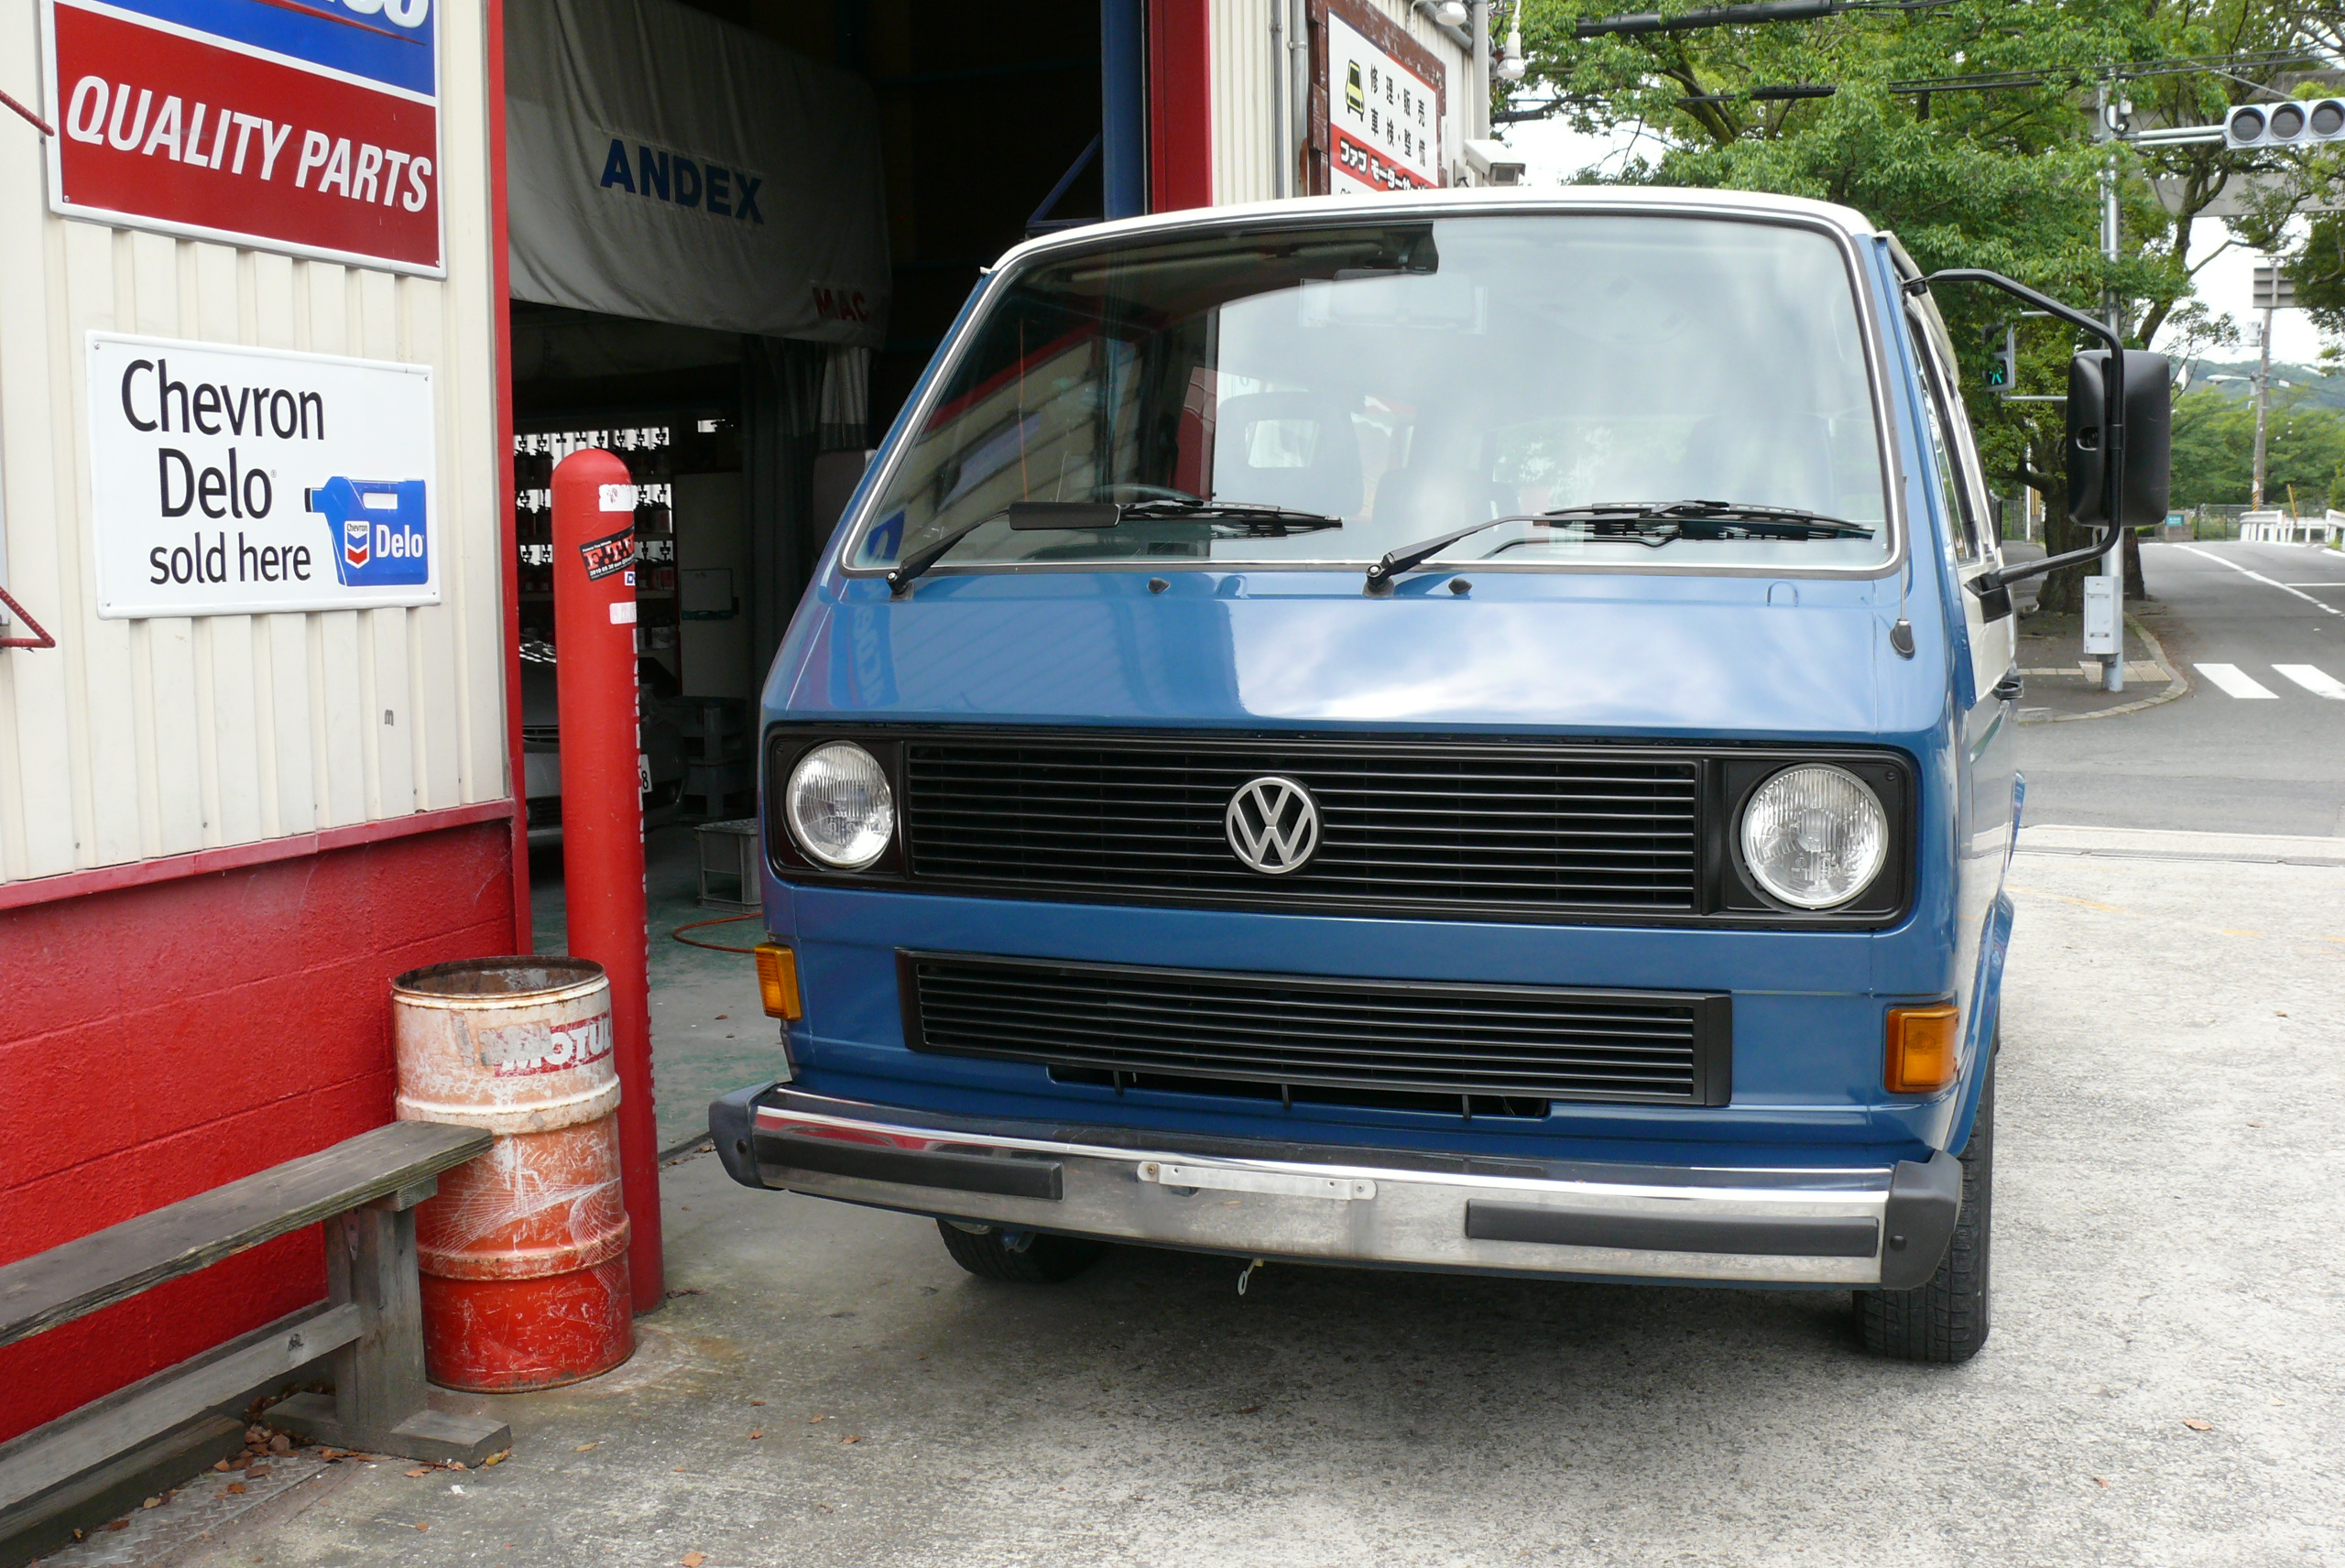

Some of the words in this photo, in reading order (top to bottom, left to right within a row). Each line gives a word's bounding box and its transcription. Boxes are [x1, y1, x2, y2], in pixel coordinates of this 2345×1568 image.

[66, 75, 292, 181] QUALITY
[295, 130, 432, 212] PARTS
[600, 138, 764, 224] ANDEX
[813, 287, 869, 322] MAC
[121, 358, 325, 441] Chevron
[149, 531, 227, 584] sold
[238, 531, 311, 583] here
[346, 523, 367, 531] Chevron
[376, 524, 423, 558] Delo
[1227, 778, 1317, 873] VW
